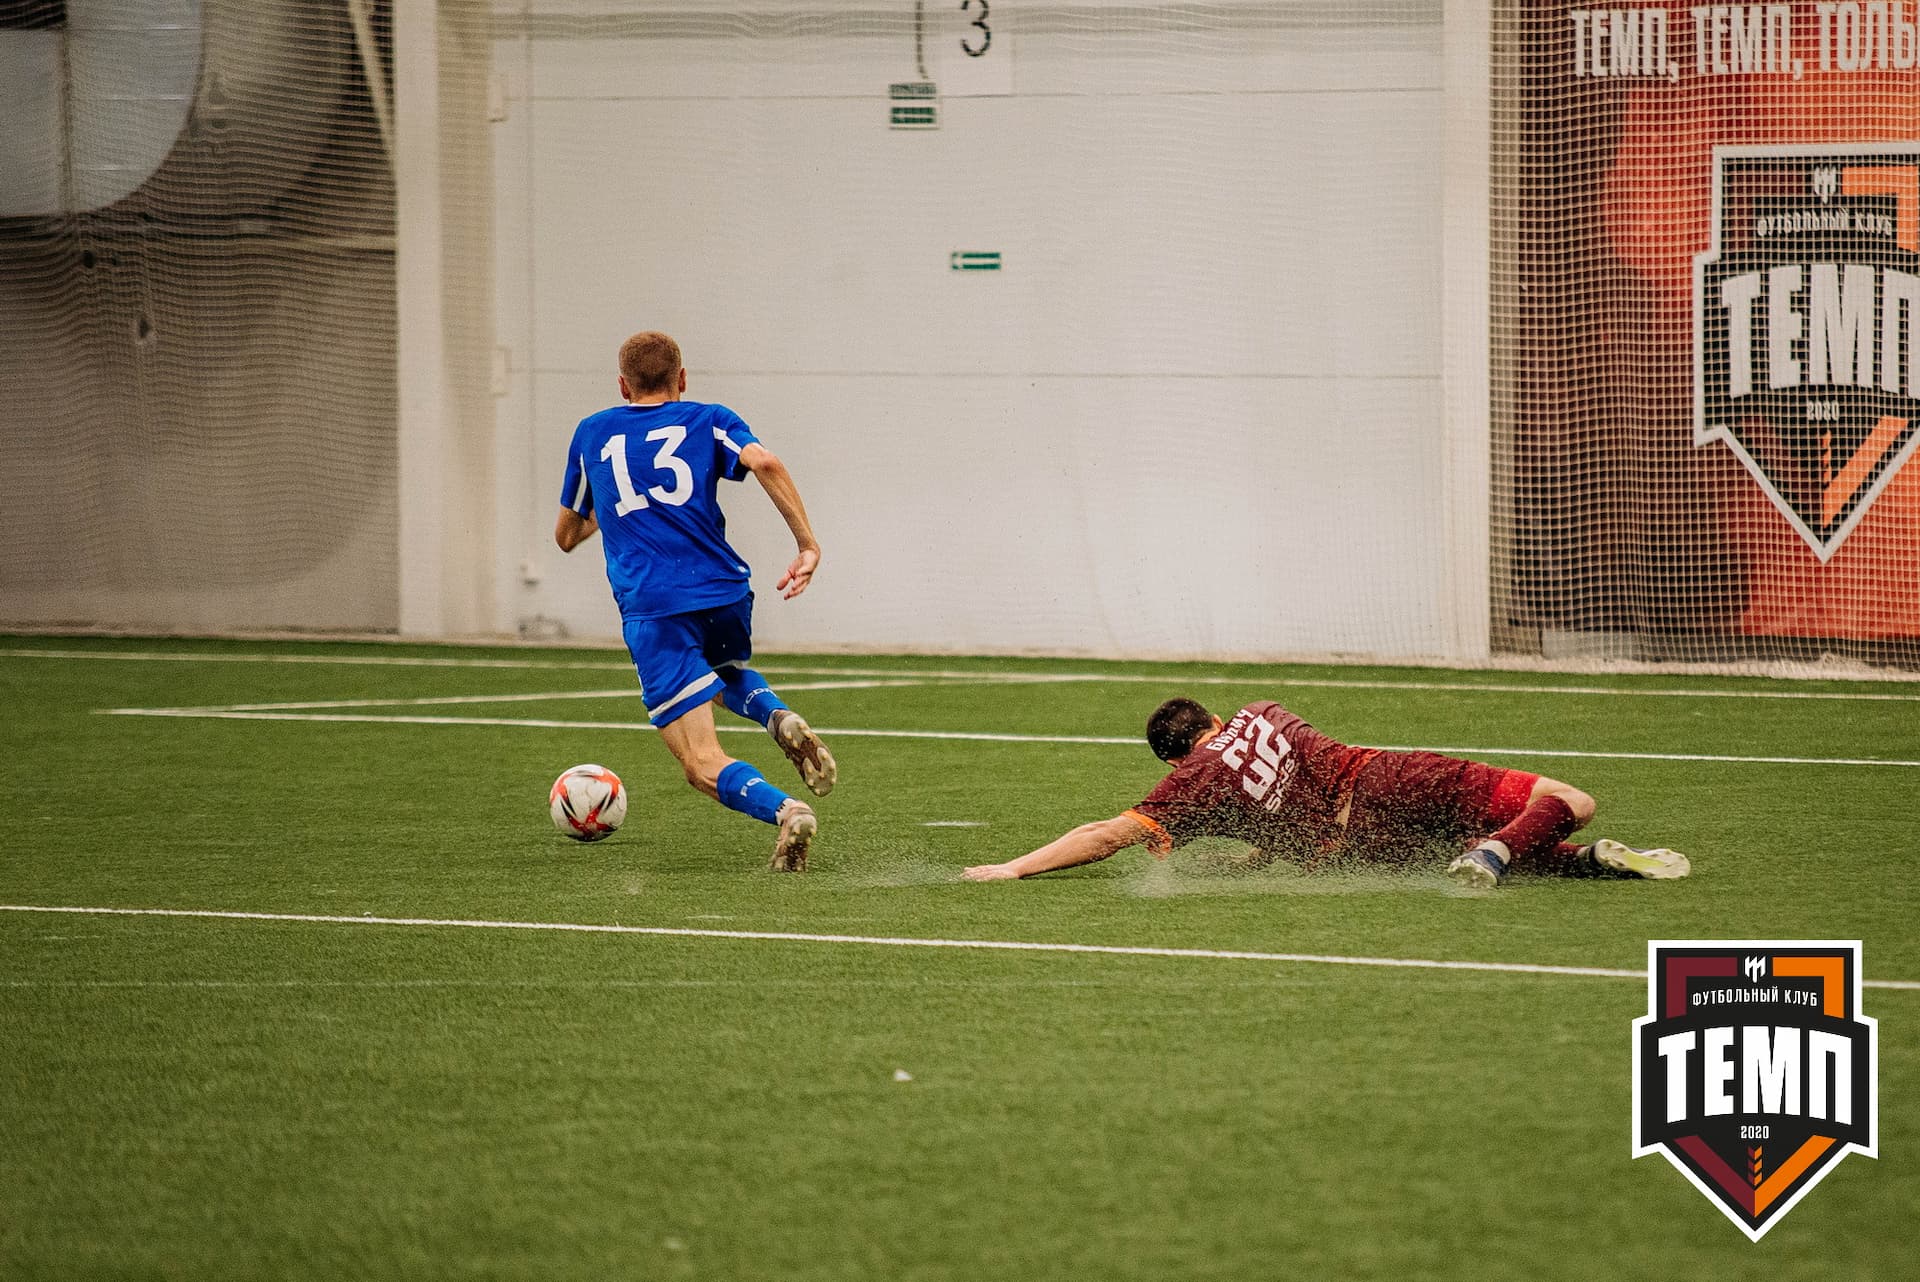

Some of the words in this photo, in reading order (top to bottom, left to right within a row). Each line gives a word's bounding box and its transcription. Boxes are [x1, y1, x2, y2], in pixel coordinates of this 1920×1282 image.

[960, 0, 991, 57] 3
[1571, 8, 1679, 82] ТЕМП,
[1692, 4, 1802, 80] ТЕМП,
[1855, 211, 1892, 236] КЛУБ
[1721, 264, 1920, 399] ТЕМП
[601, 425, 694, 517] 13
